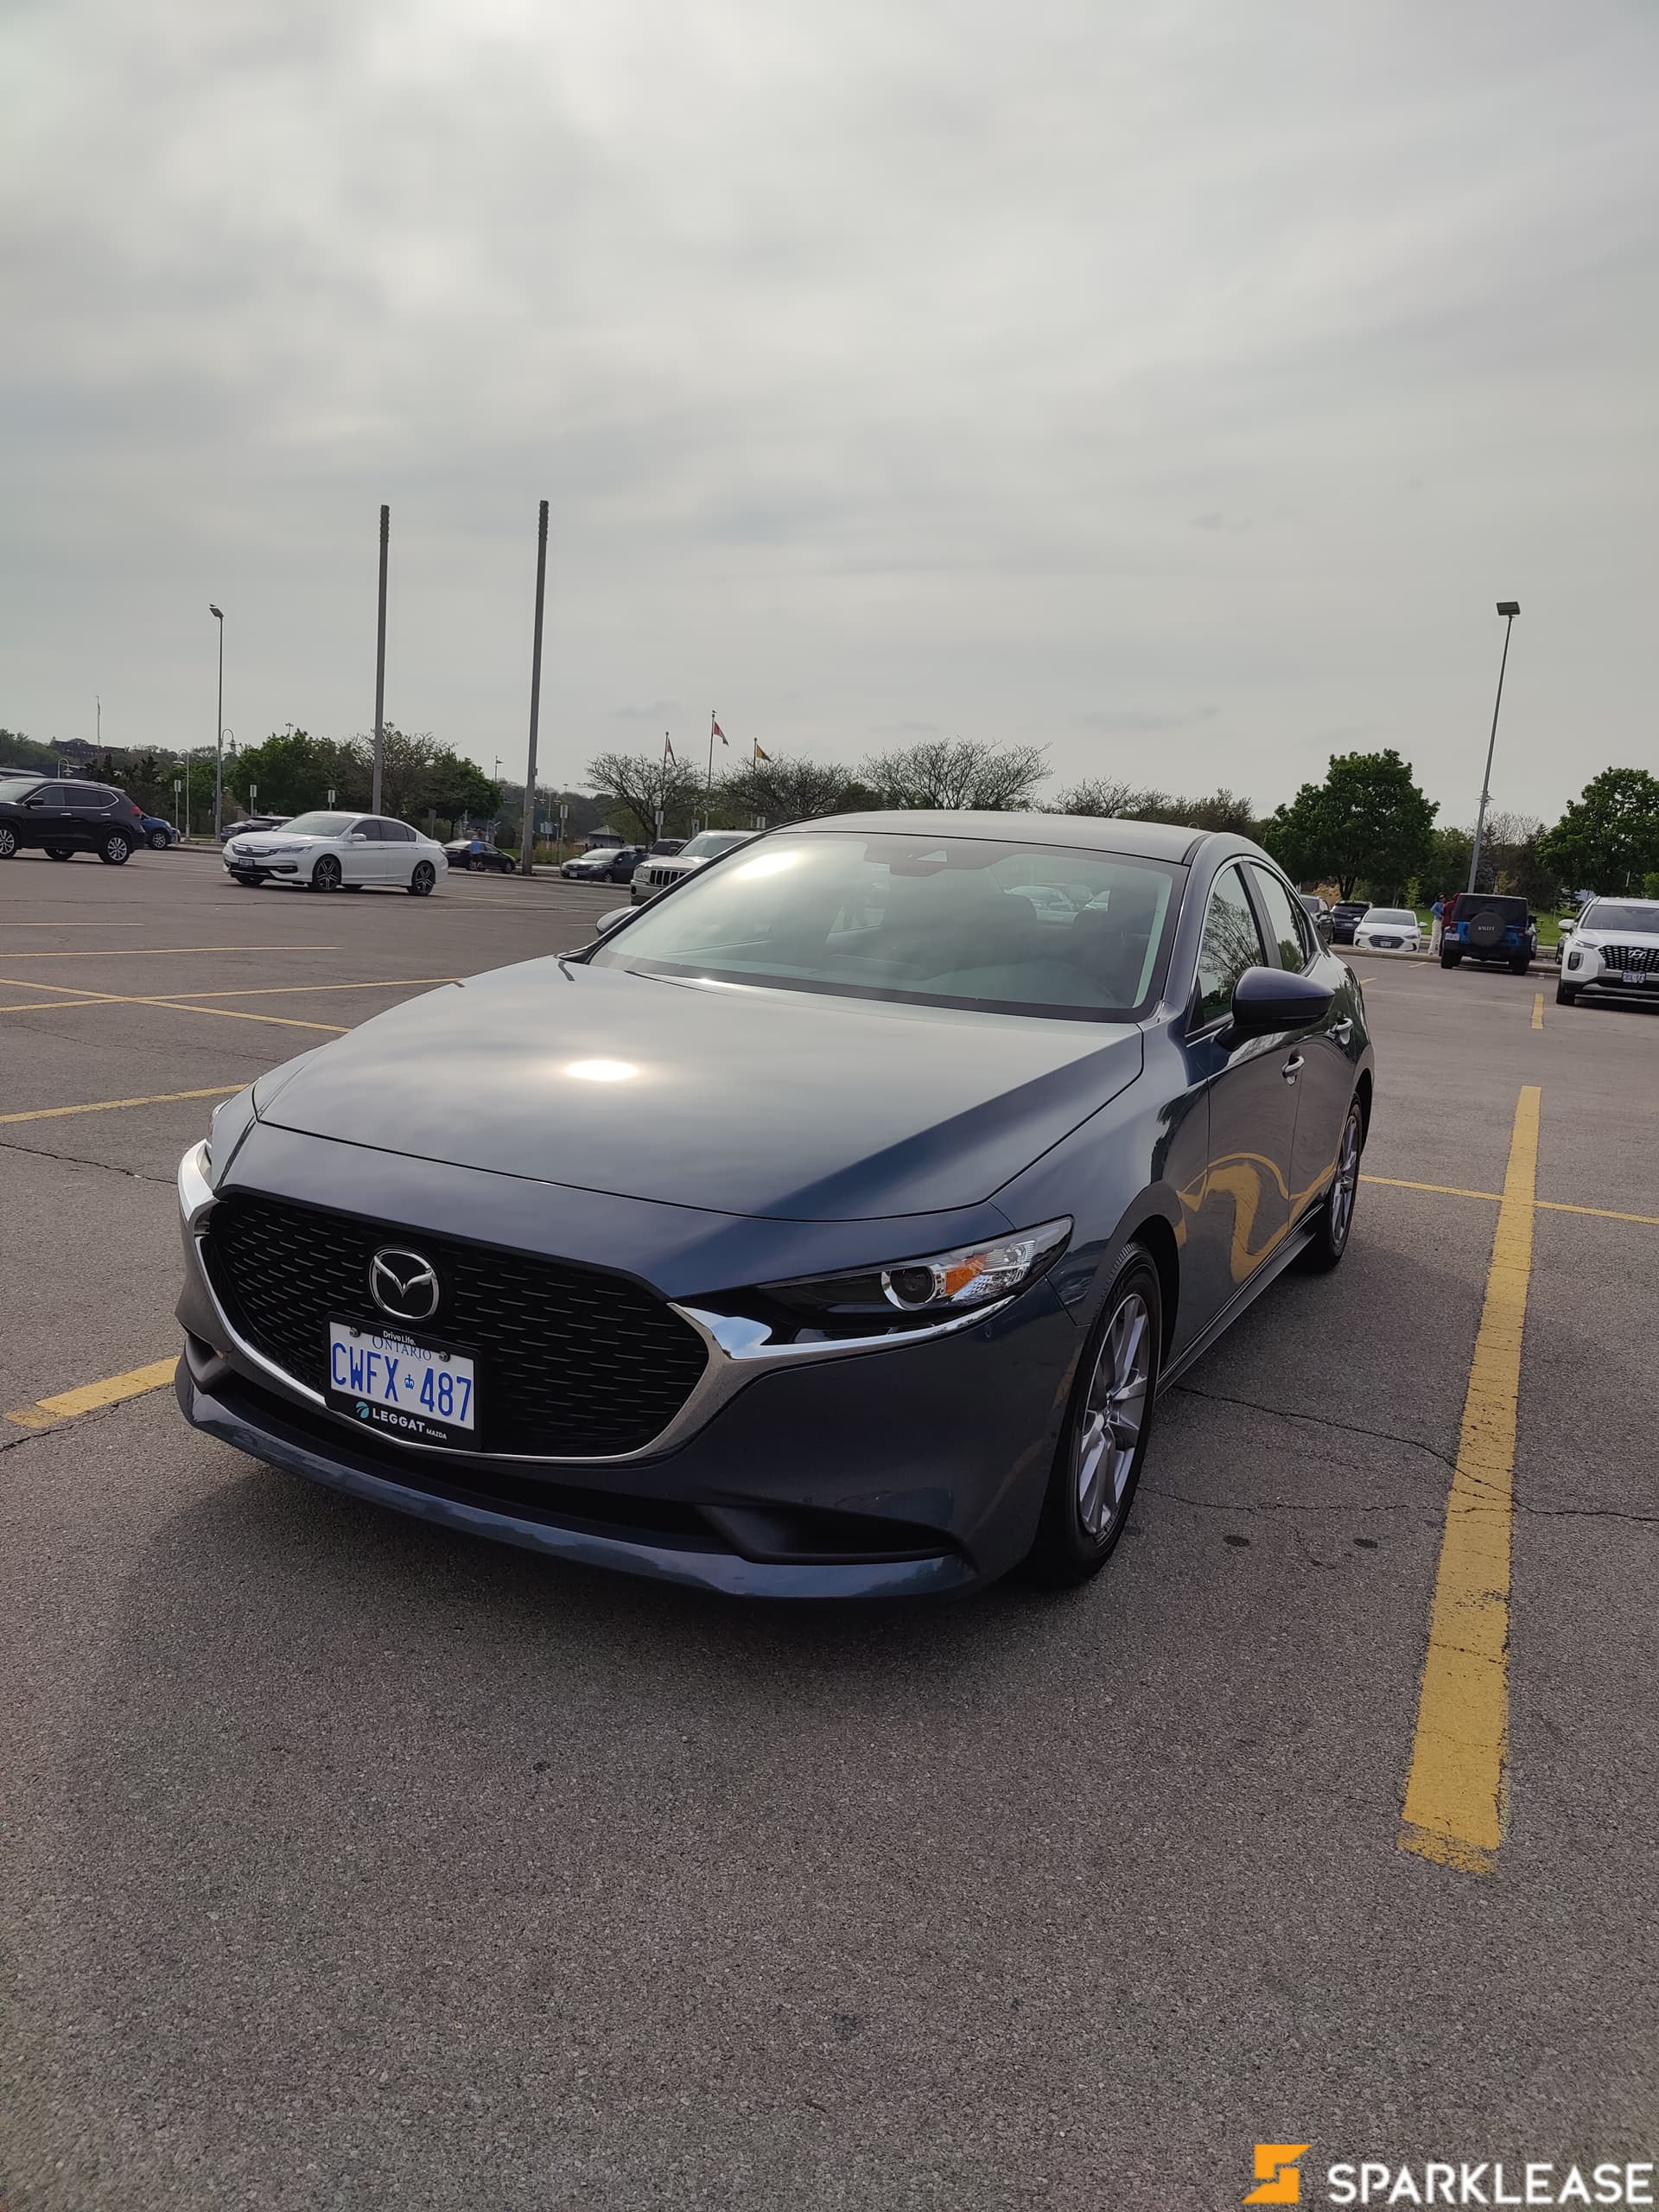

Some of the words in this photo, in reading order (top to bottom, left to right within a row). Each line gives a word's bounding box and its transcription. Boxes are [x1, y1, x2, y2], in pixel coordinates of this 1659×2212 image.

[372, 1335, 432, 1361] ONTARIO
[332, 1342, 398, 1402] CWFX
[420, 1367, 472, 1422] 487
[372, 1408, 425, 1433] LEGGAT
[426, 1428, 448, 1440] MAZDA
